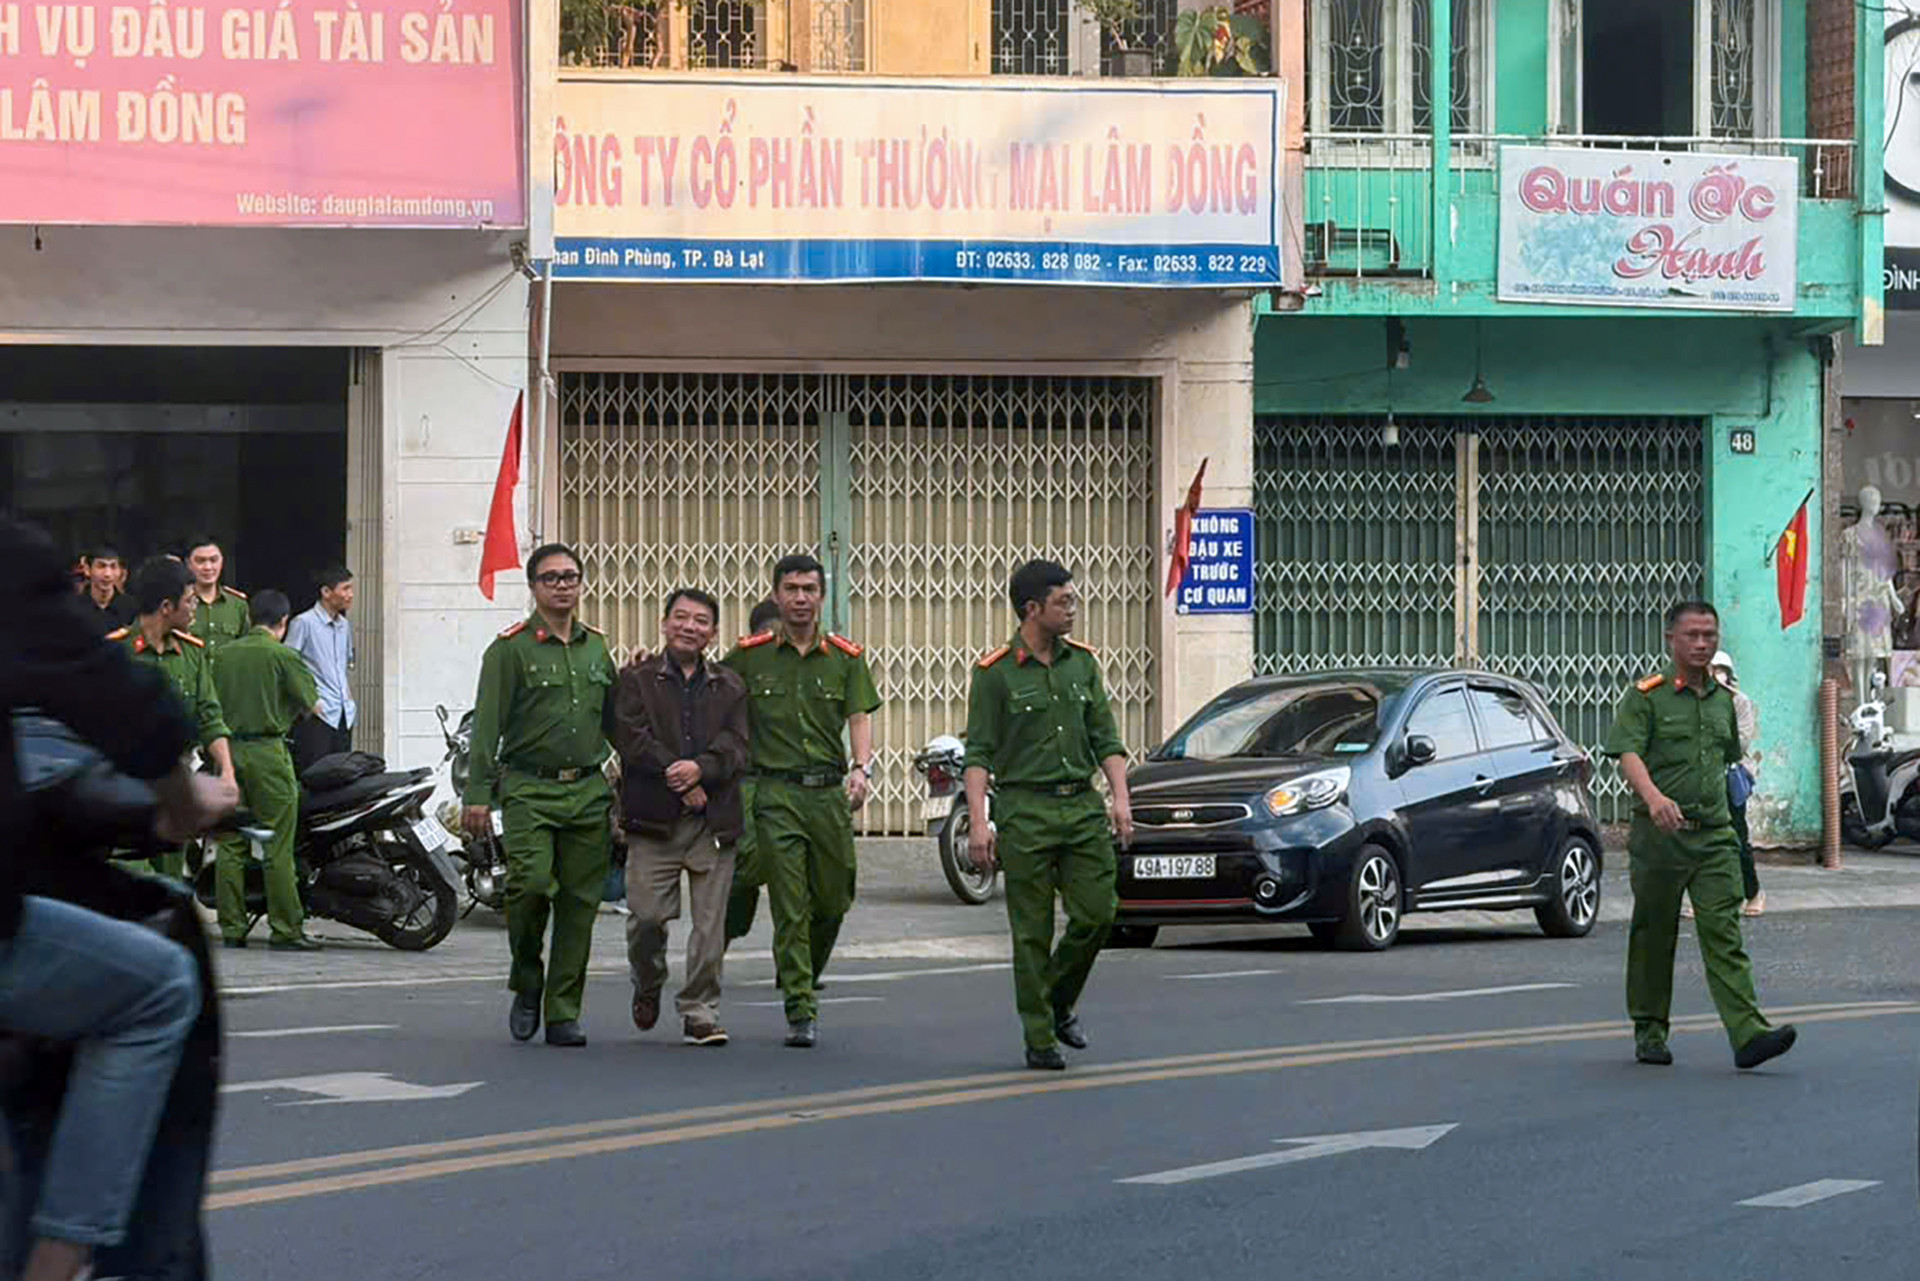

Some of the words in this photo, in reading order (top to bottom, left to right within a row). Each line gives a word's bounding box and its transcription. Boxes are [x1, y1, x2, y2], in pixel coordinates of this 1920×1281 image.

[35, 5, 95, 68] VỤ
[221, 0, 300, 60] GIÁ
[313, 0, 384, 62] TÀI
[400, 0, 494, 64] SẢN
[0, 78, 101, 141] LÂM
[116, 74, 247, 144] ĐỒNG
[634, 136, 680, 207] TY
[690, 98, 736, 209] CỔ
[749, 105, 843, 209] PHẦN
[1009, 141, 1070, 233] MẠI
[1083, 126, 1151, 214] LÂM
[1166, 112, 1257, 216] ĐỒNG
[1519, 164, 1675, 217] Quán
[236, 193, 317, 215] Website:
[585, 247, 619, 265] Đình
[625, 248, 676, 269] Phùng,
[682, 251, 706, 268] TP.
[714, 249, 734, 268] Đà
[740, 250, 764, 270] Lạt
[956, 251, 981, 269] ĐT:
[987, 250, 1036, 270] 02633.
[1042, 251, 1069, 270] 828
[1075, 252, 1100, 270] 082
[1118, 254, 1148, 272] Fax:
[1154, 254, 1202, 272] 02633.
[1208, 252, 1234, 271] 822
[1240, 253, 1266, 273] 229
[1612, 224, 1767, 284] Hạnh
[1731, 433, 1753, 451] 48
[1190, 515, 1239, 534] KHÔNG
[1223, 541, 1243, 556] XE
[1192, 561, 1239, 580] TRƯỚC
[1184, 585, 1203, 604] CƠ
[1207, 587, 1247, 605] QUAN
